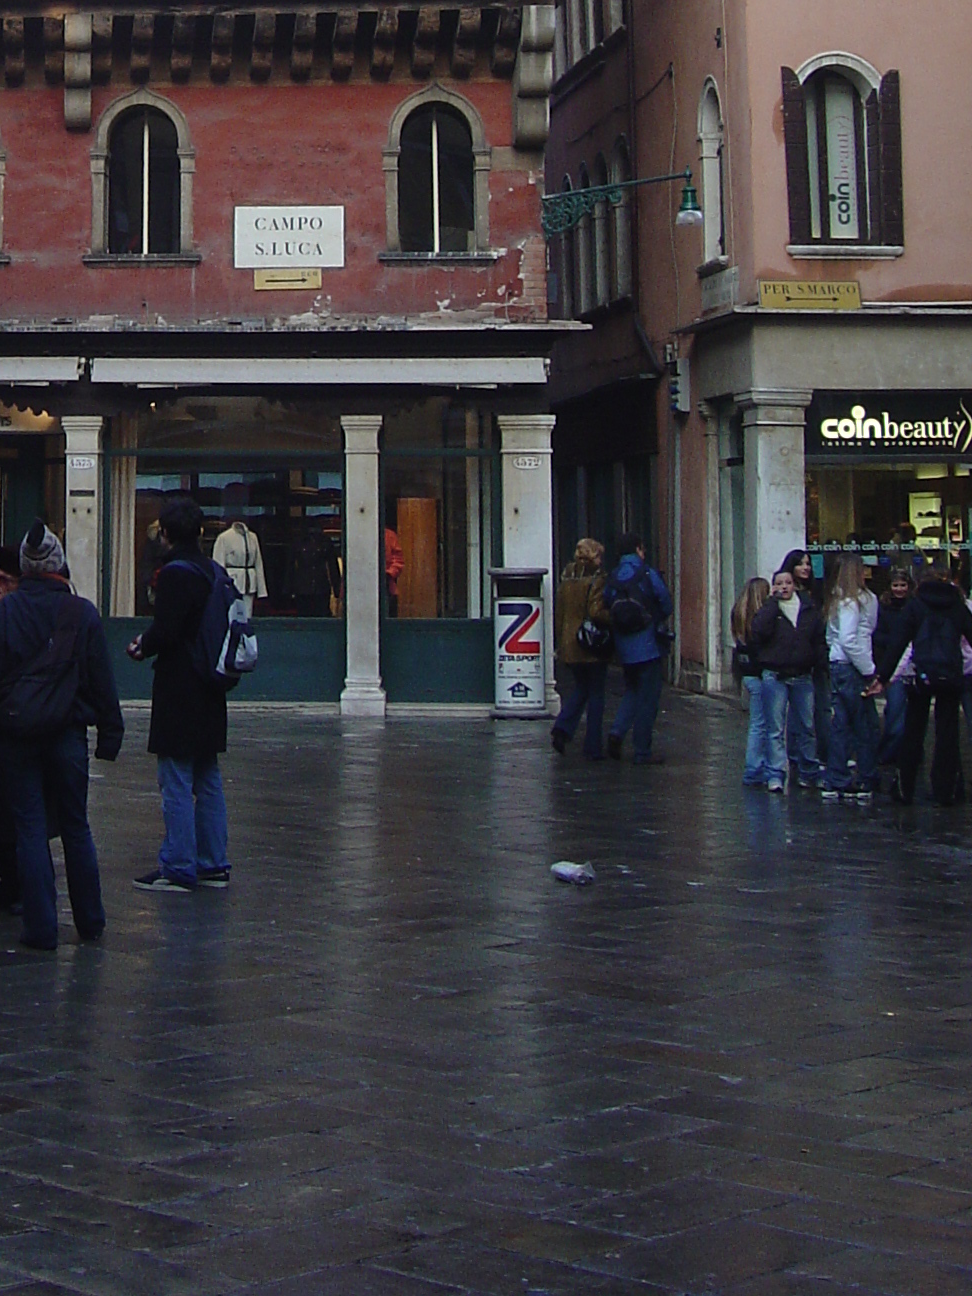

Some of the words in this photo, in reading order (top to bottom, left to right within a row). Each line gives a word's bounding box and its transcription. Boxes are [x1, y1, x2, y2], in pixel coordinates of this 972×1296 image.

[254, 216, 323, 231] CAMPO
[763, 284, 790, 295] PER
[823, 540, 842, 551] coin
[842, 540, 861, 551] coin
[862, 540, 880, 551] coin
[881, 540, 899, 551] coin
